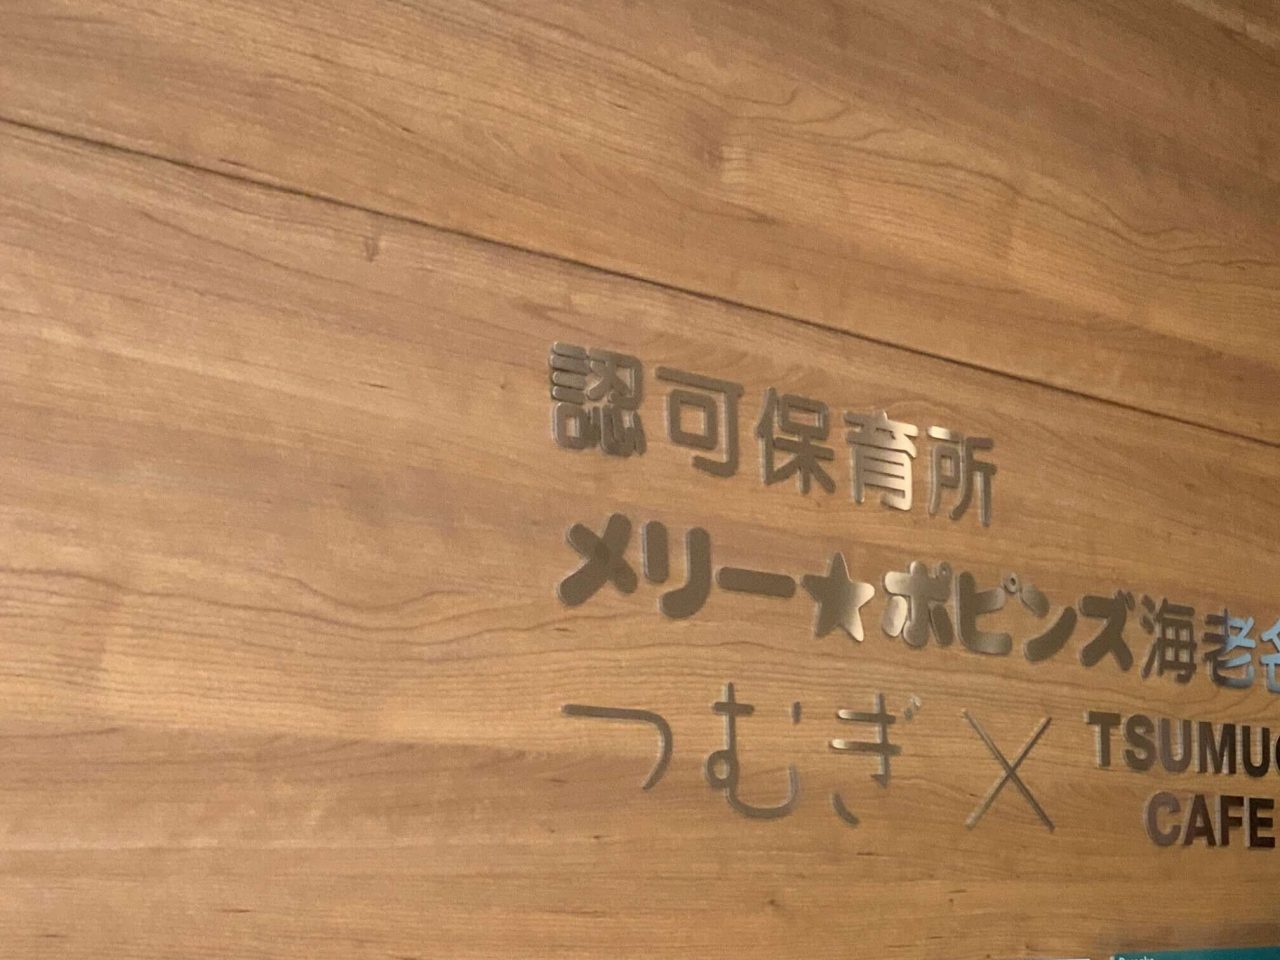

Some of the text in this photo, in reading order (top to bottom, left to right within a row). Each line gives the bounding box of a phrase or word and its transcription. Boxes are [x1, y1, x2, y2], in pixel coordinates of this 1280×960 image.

[548, 341, 997, 527] 認可保育所
[1145, 792, 1276, 850] CAFE
